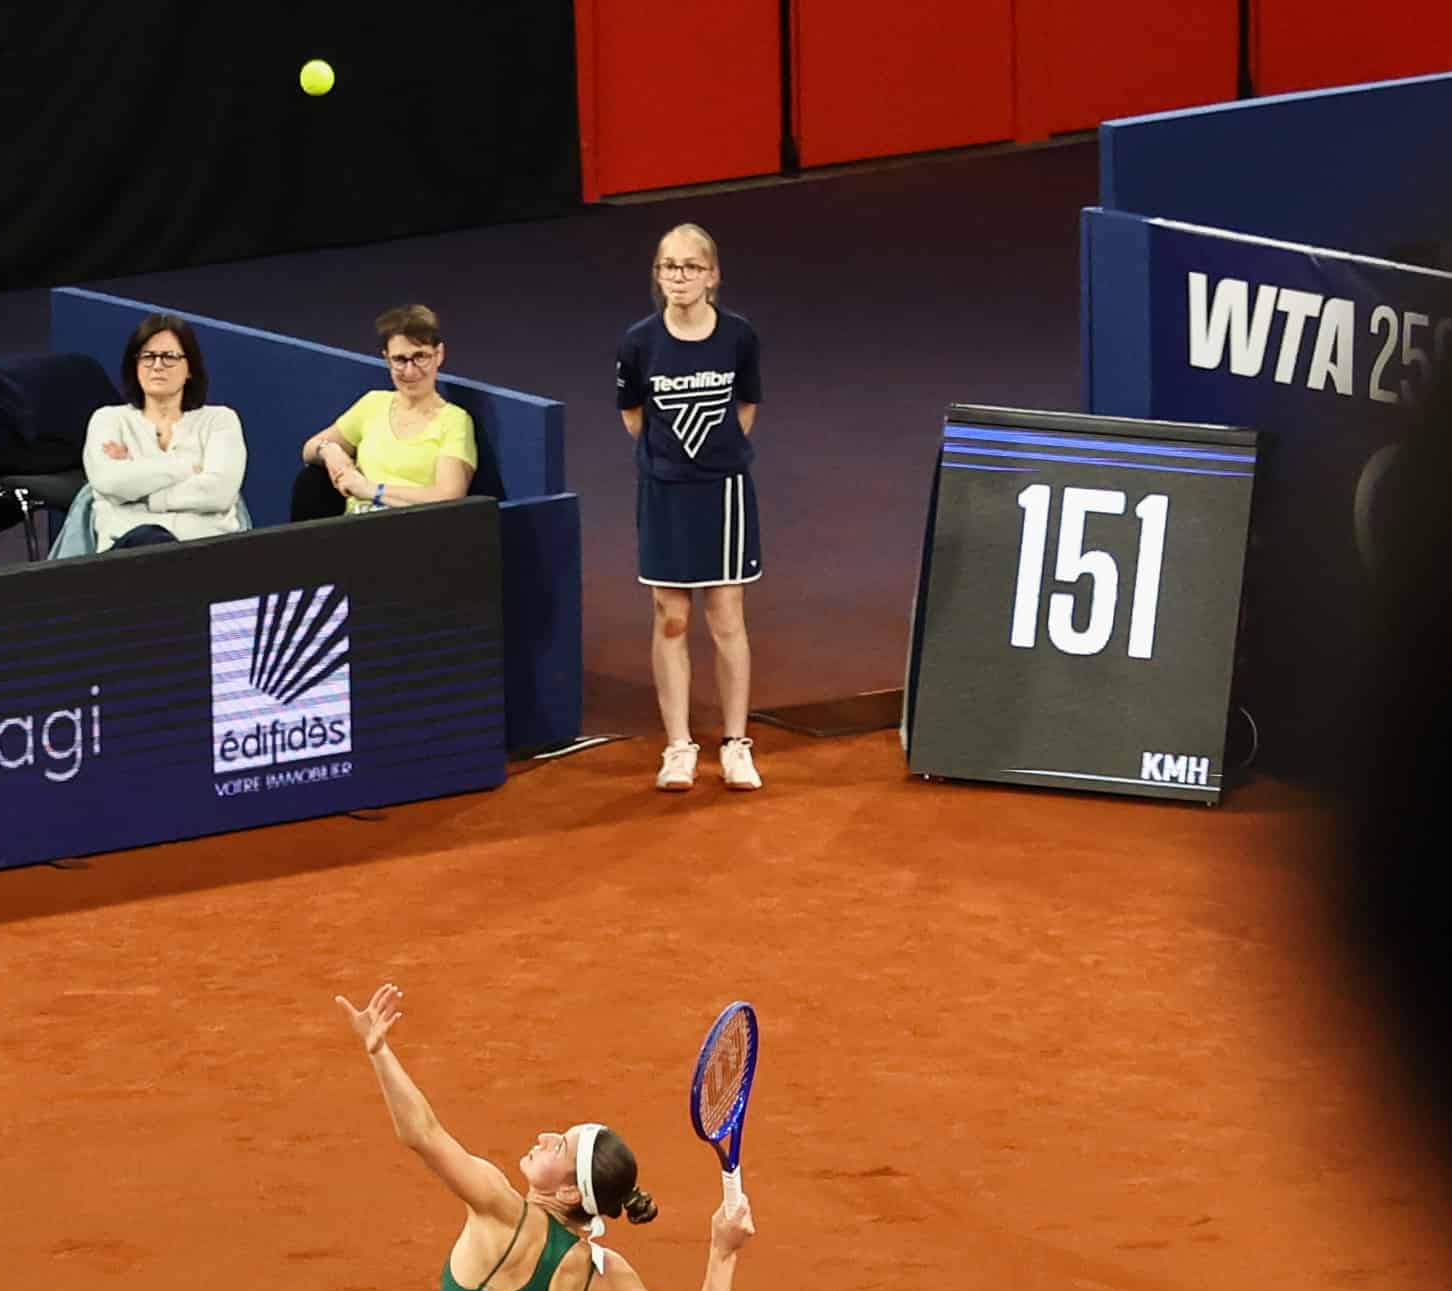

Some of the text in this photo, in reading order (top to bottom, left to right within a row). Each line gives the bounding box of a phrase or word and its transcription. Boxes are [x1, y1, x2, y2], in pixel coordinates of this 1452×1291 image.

[1188, 271, 1356, 397] WTA
[1008, 482, 1170, 661] 151
[218, 715, 347, 765] édifidès
[1140, 751, 1210, 785] KMH
